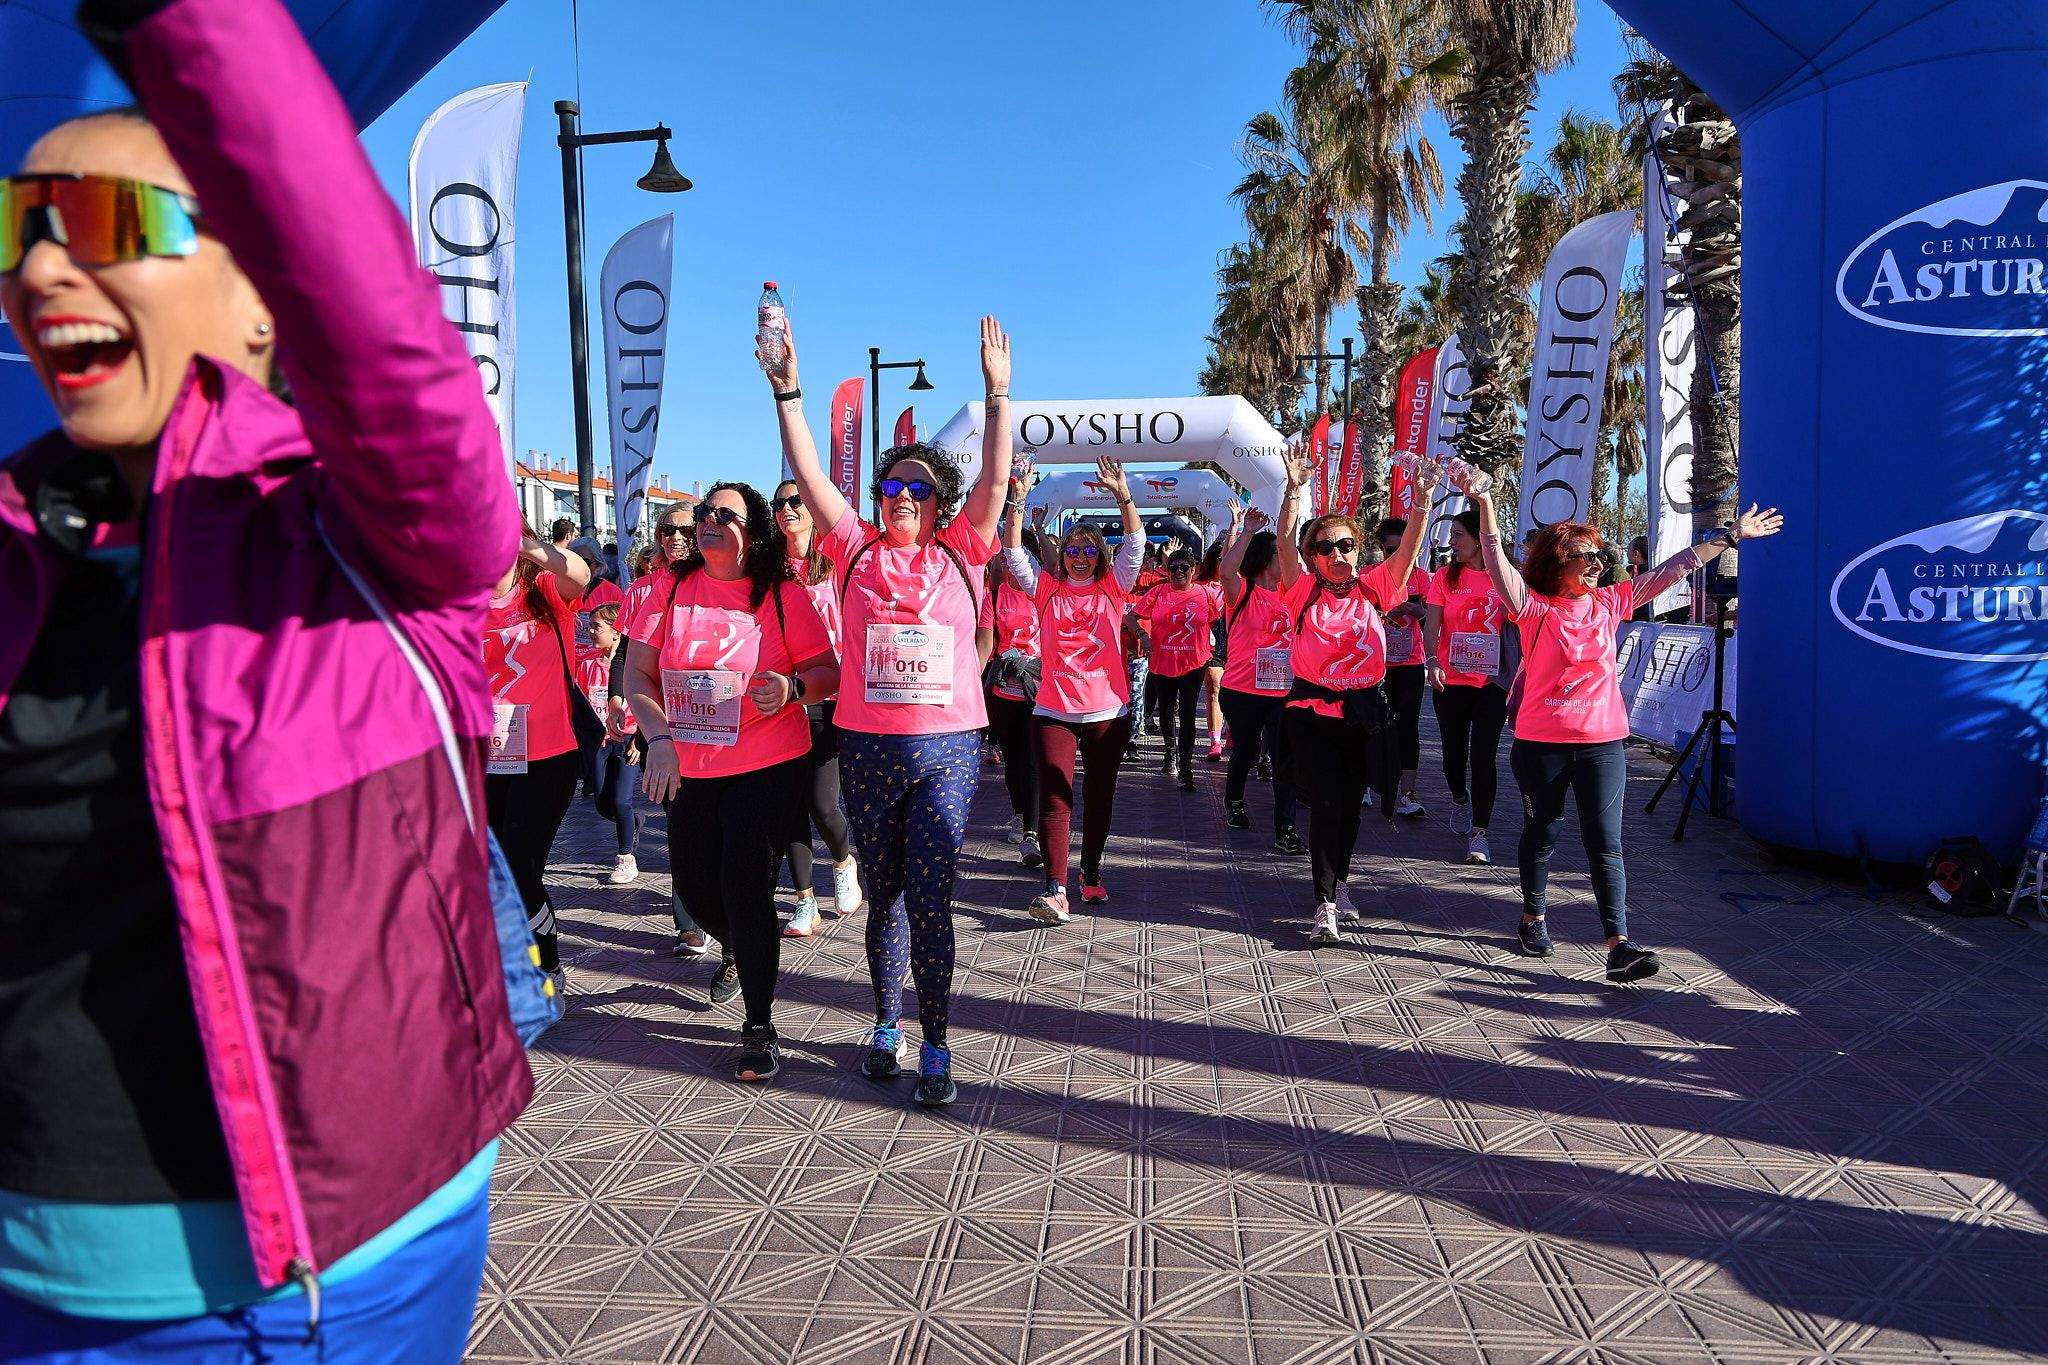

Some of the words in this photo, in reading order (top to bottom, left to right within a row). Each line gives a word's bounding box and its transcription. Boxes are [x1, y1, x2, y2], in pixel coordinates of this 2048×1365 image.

[1921, 235, 2035, 255] CENTRAL
[1861, 249, 2048, 307] ASTUR
[1531, 266, 1608, 530] OYSHO
[1020, 411, 1185, 447] OYSHO
[839, 402, 855, 494] Santander
[1914, 563, 2026, 578] CENTRAL
[1466, 651, 1485, 659] 016
[1616, 635, 1711, 692] OYSHO
[895, 659, 928, 673] 016
[1272, 666, 1288, 674] 016
[874, 691, 902, 699] OYSHO
[690, 702, 717, 716] 016
